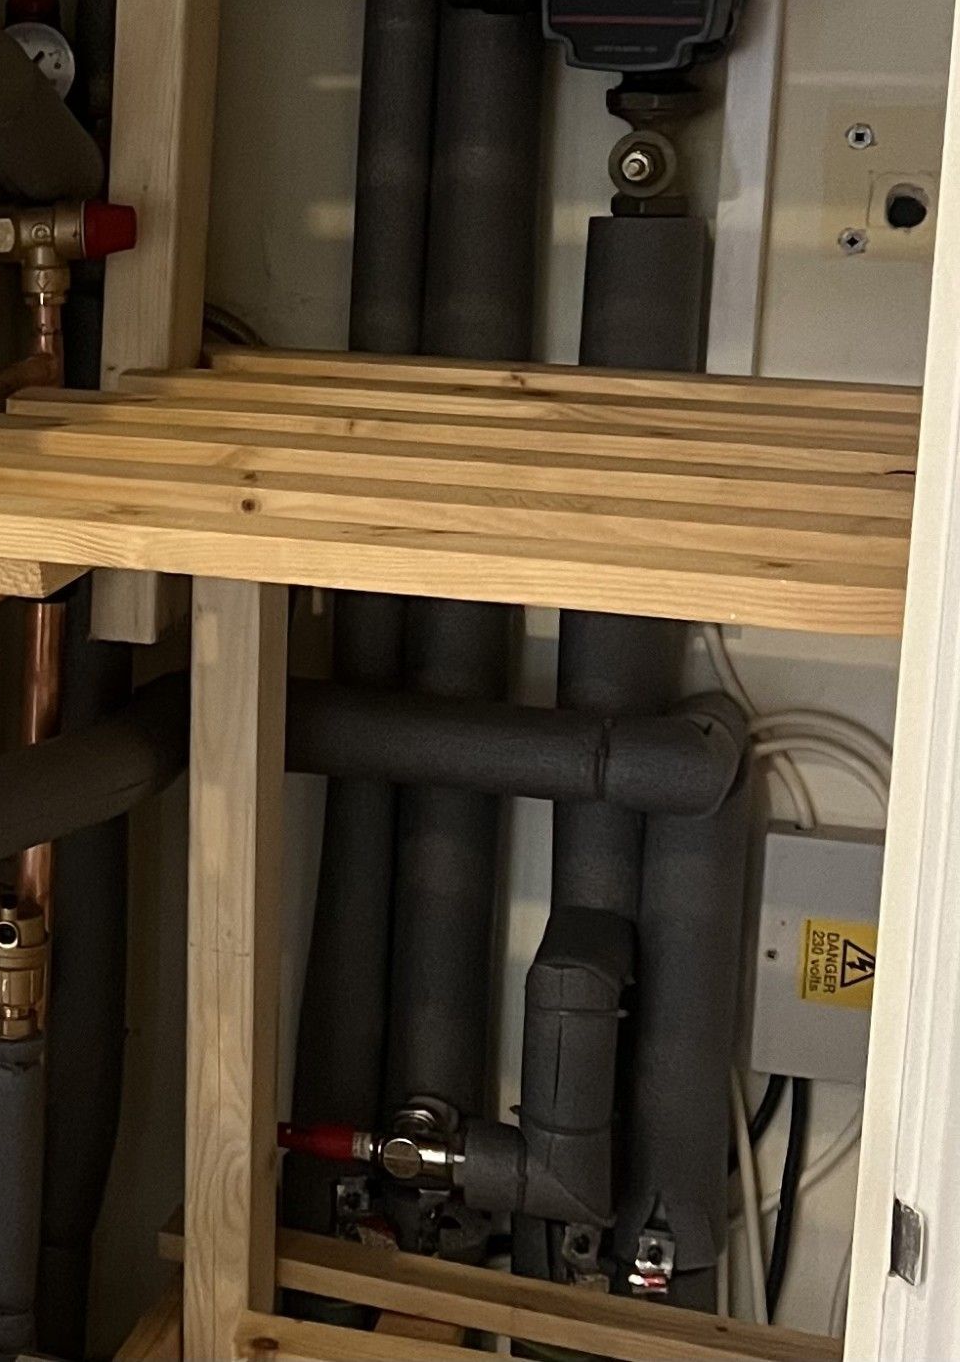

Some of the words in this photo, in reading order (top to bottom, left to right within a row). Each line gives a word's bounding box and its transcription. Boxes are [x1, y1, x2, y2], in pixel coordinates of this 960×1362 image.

[812, 930, 825, 955] 230
[809, 958, 822, 992] volts
[823, 932, 840, 993] DANGER
